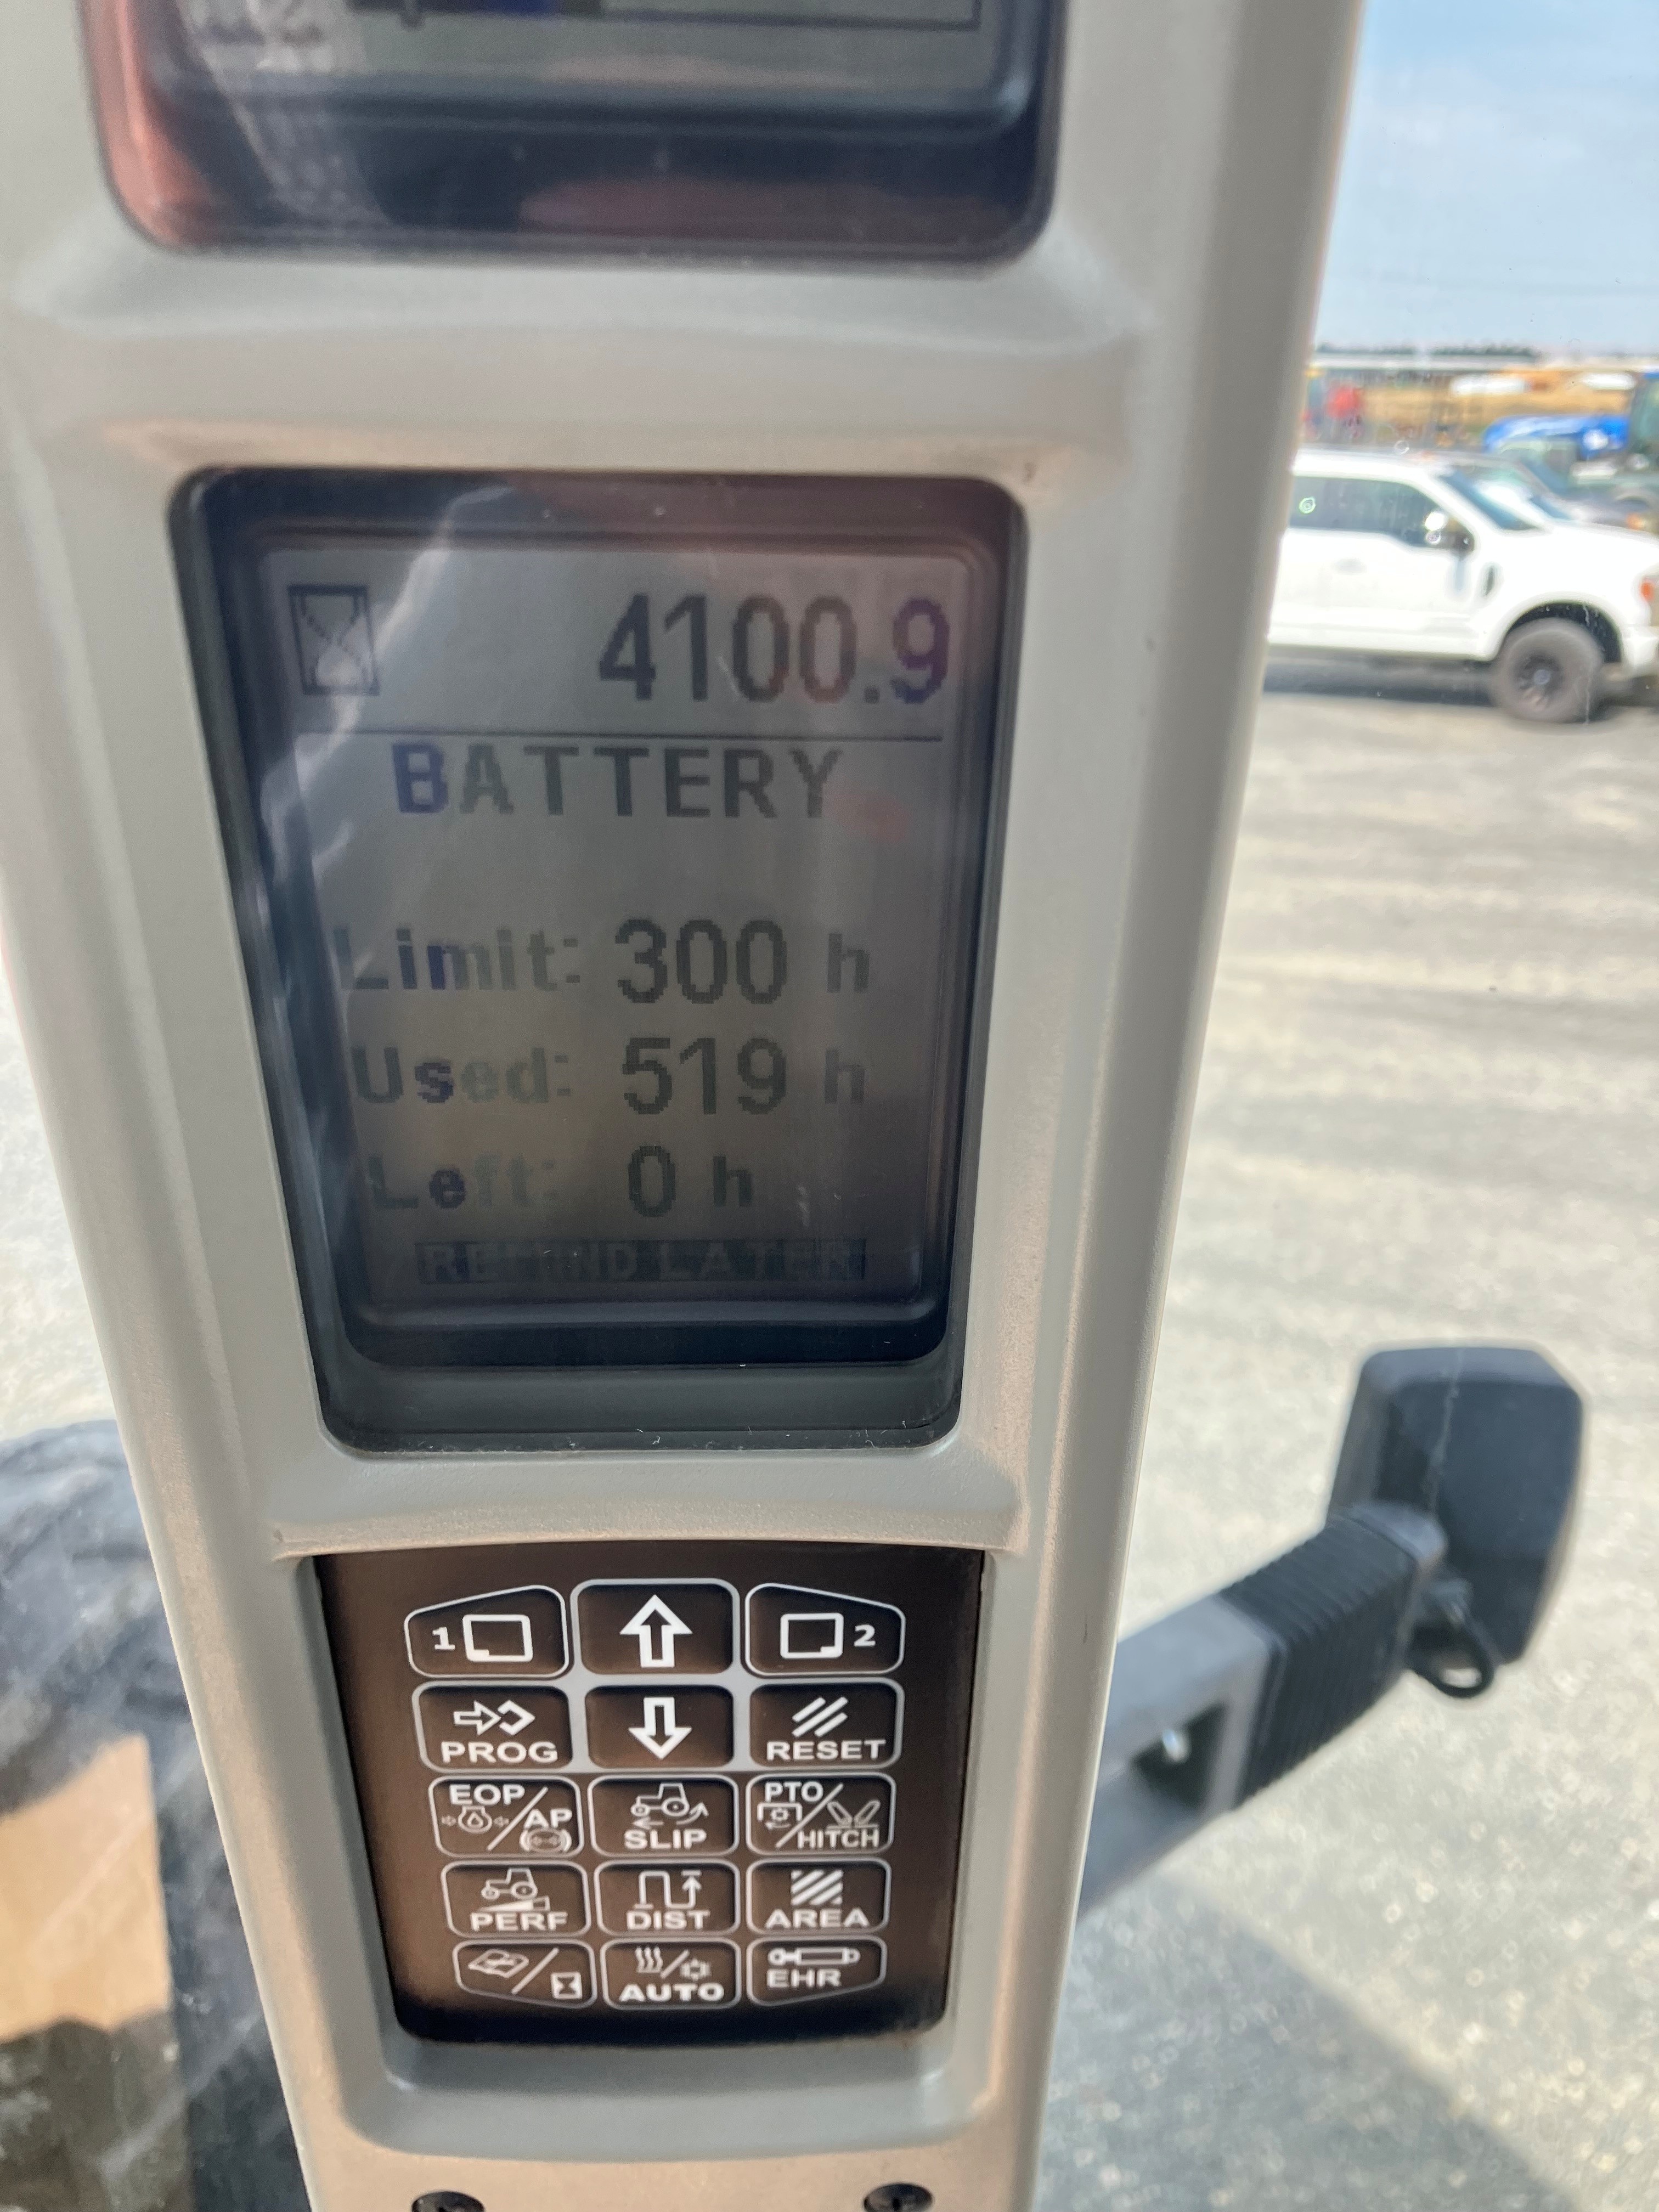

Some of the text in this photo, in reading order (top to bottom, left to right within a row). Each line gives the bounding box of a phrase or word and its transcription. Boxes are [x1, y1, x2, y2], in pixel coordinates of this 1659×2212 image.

[598, 593, 950, 705] 4100.9
[392, 742, 844, 819] BATTERY
[332, 918, 871, 1005] Limit: 300 h
[350, 1036, 867, 1116] Used: 519 h
[368, 1144, 754, 1218] Left: 0 h
[432, 1627, 456, 1650] 1
[853, 1624, 877, 1647] 2
[441, 1741, 558, 1763] PROG
[766, 1739, 887, 1761] RESET
[449, 1784, 525, 1805] EOP
[764, 1781, 824, 1803] PTO
[523, 1808, 573, 1829] AP
[624, 1829, 707, 1850] SLIP
[797, 1830, 879, 1849] HITCH
[470, 1911, 568, 1932] PERF
[626, 1909, 710, 1930] DIST
[764, 1909, 870, 1929] AREA
[766, 1968, 843, 1988] EHR
[619, 1983, 725, 2002] AUTO
